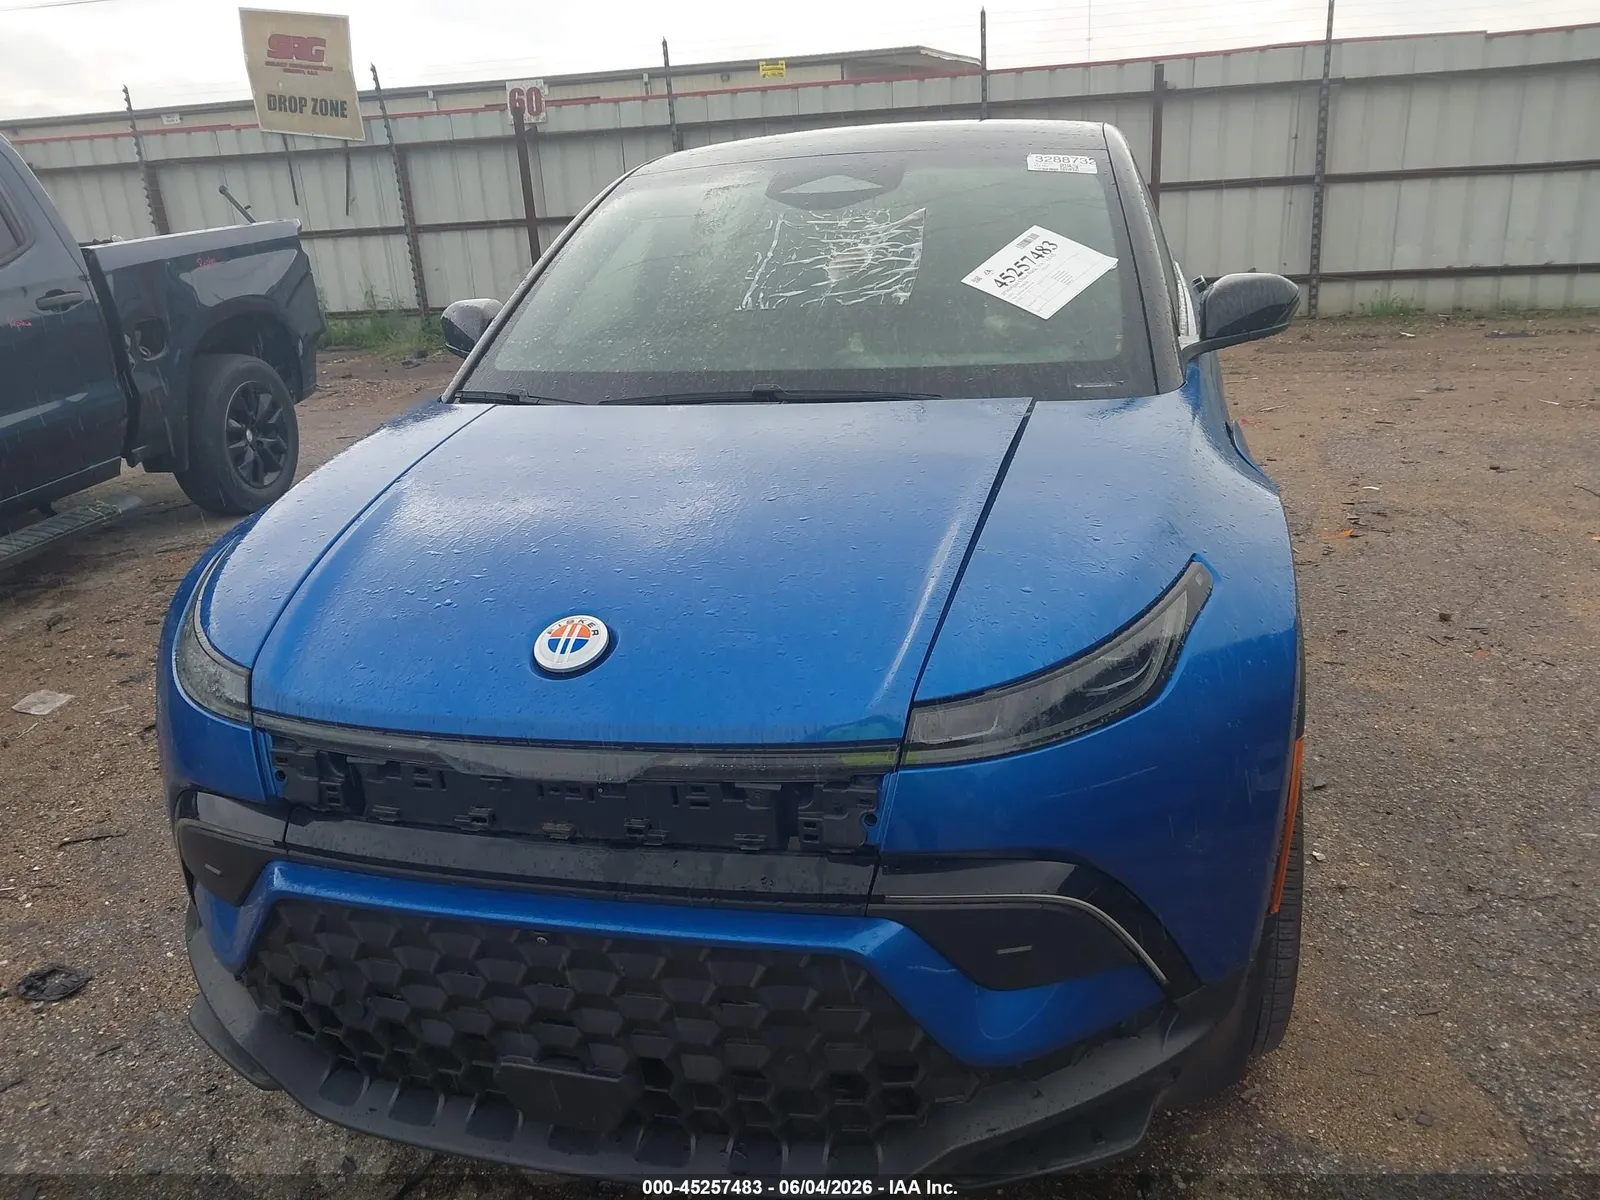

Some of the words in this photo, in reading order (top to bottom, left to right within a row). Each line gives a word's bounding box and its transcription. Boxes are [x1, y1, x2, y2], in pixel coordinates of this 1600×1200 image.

[267, 93, 307, 114] DROP
[311, 97, 348, 118] ZONE
[509, 86, 543, 117] 60
[993, 240, 1058, 288] 45257483
